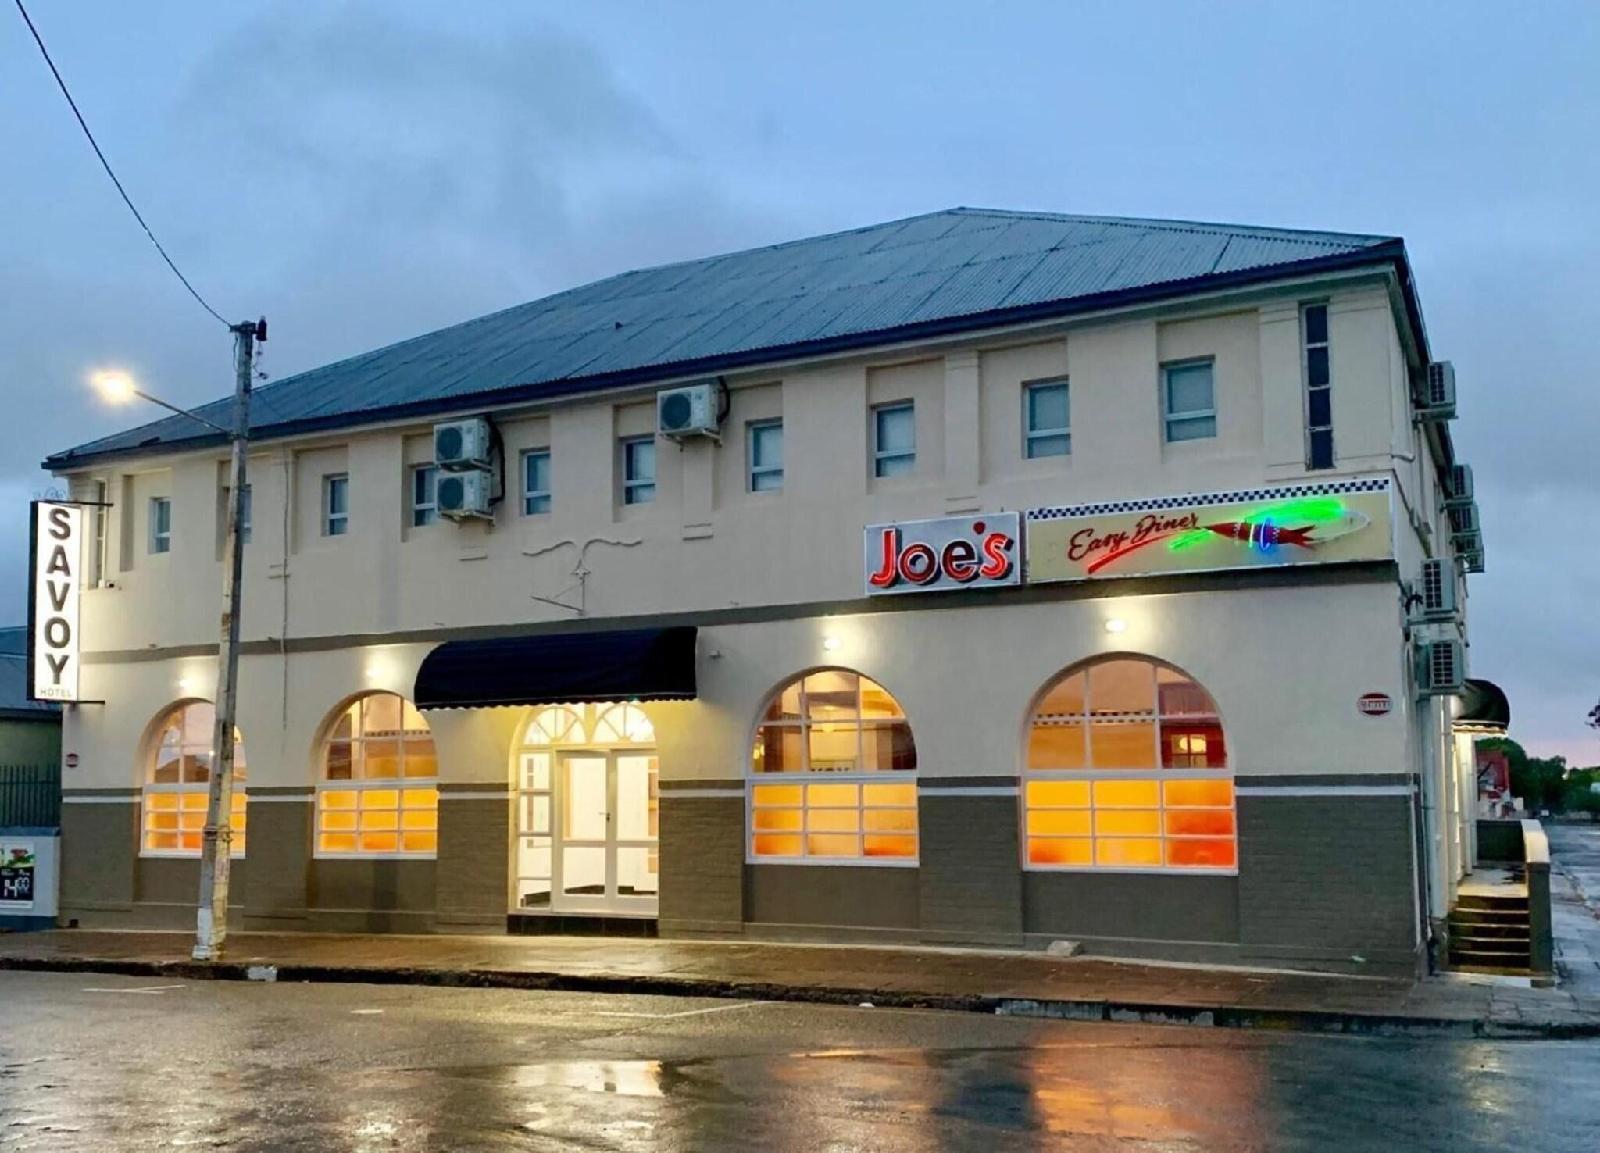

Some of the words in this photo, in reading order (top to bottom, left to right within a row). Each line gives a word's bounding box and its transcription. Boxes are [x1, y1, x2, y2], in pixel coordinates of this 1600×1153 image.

[869, 521, 1014, 588] Joe's
[1068, 528, 1129, 561] Easy
[1131, 512, 1199, 544] Diner
[44, 508, 71, 685] SAVOY
[40, 688, 73, 697] HOTEL
